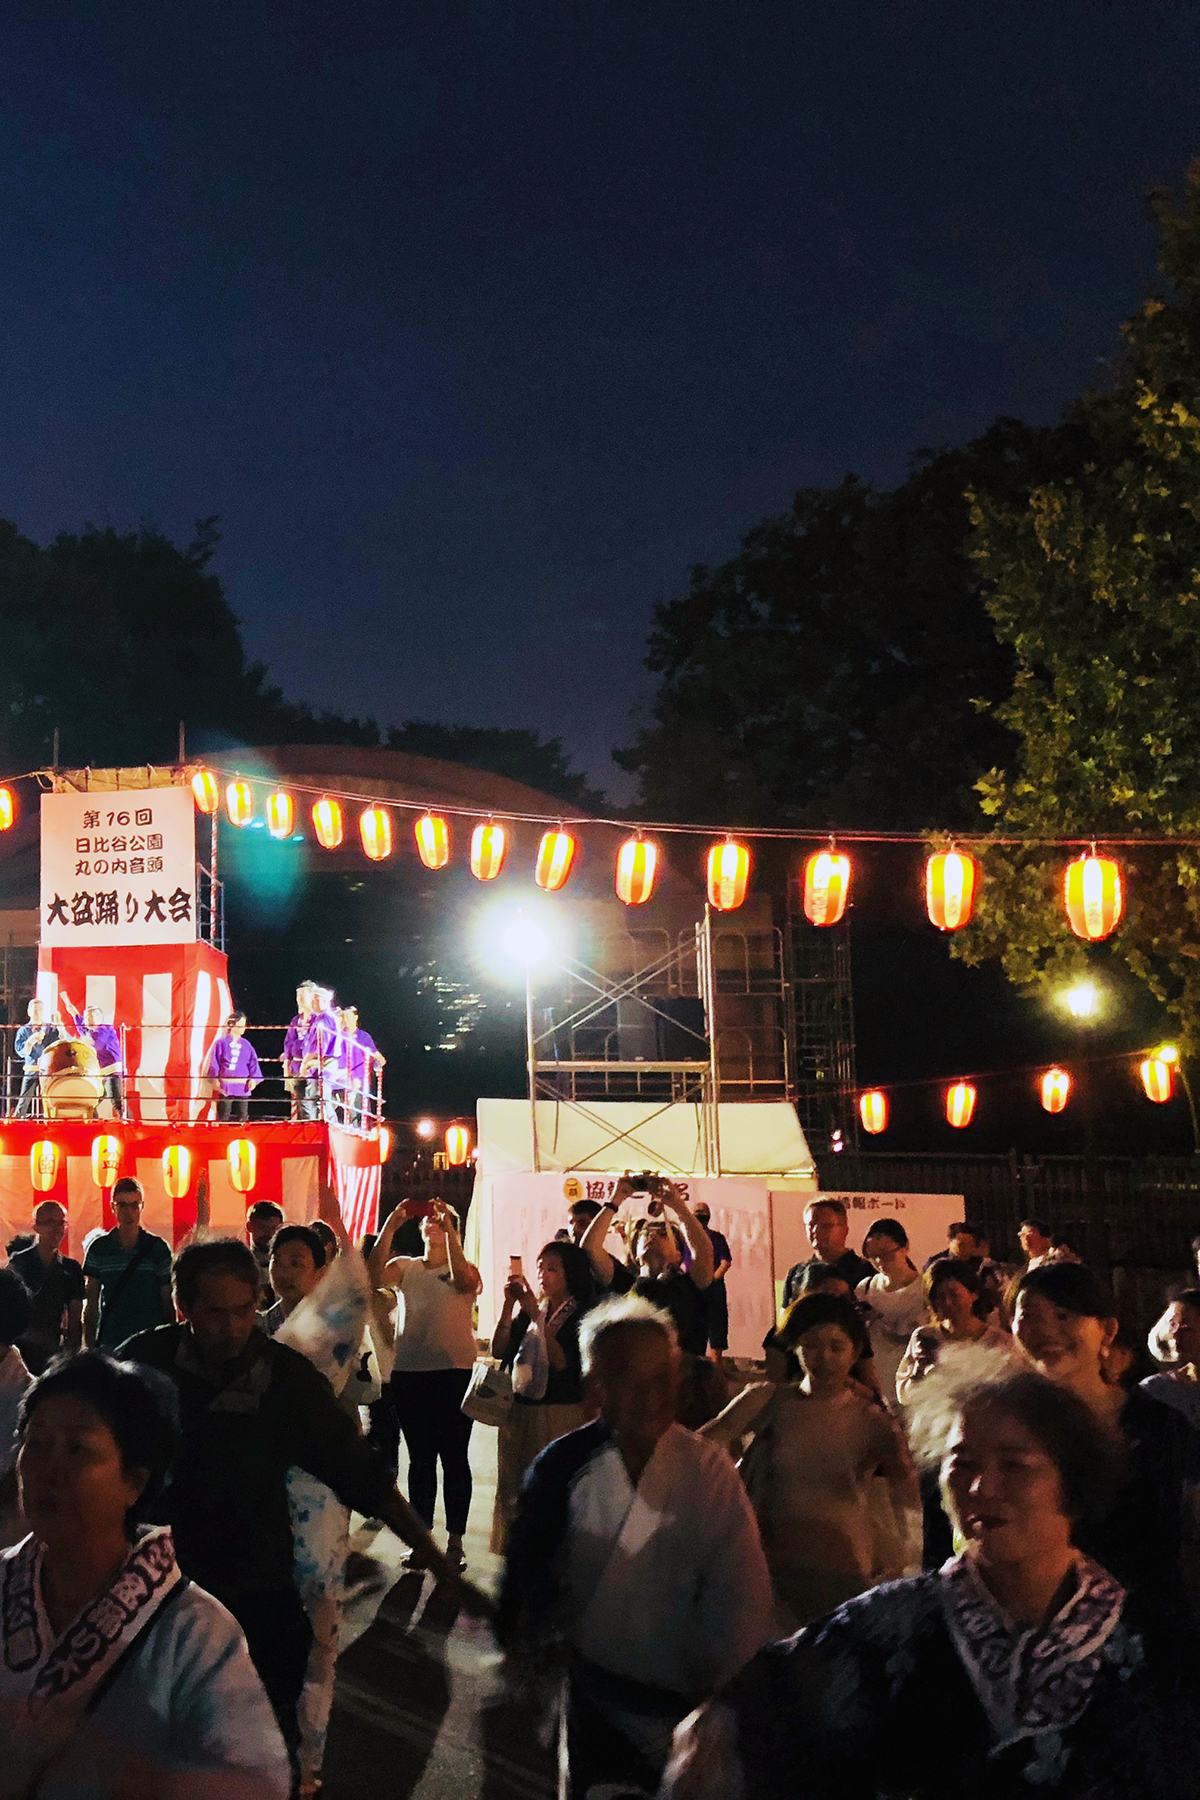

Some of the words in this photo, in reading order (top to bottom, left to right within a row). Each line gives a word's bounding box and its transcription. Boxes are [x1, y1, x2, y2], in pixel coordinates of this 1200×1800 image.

[83, 808, 153, 829] 第16回
[75, 833, 163, 854] 日比谷公園
[75, 856, 164, 875] 丸の内音頭
[46, 887, 192, 926] 大盆踊り大会
